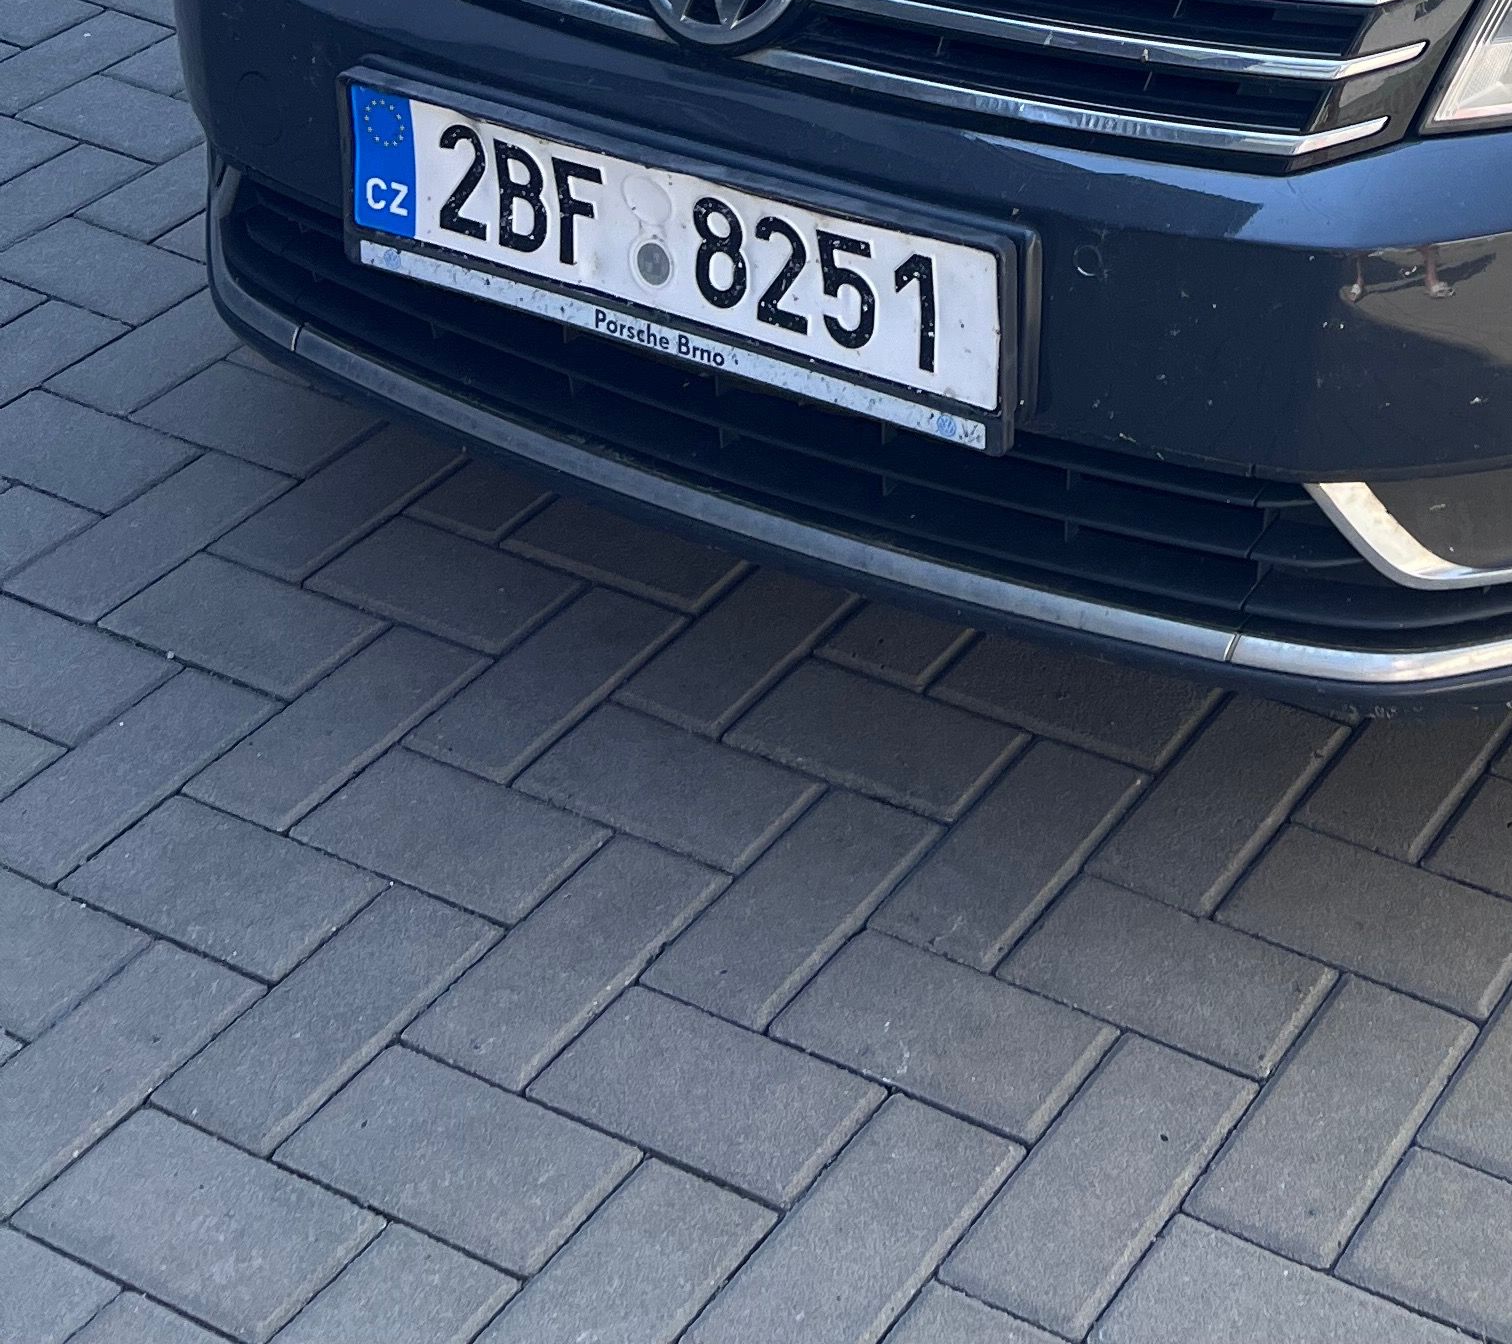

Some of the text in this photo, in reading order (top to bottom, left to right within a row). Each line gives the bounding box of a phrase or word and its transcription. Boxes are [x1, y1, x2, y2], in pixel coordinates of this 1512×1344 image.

[366, 178, 408, 216] CZ
[439, 124, 935, 373] 2BF 8251
[595, 309, 725, 367] Porsche Brno
